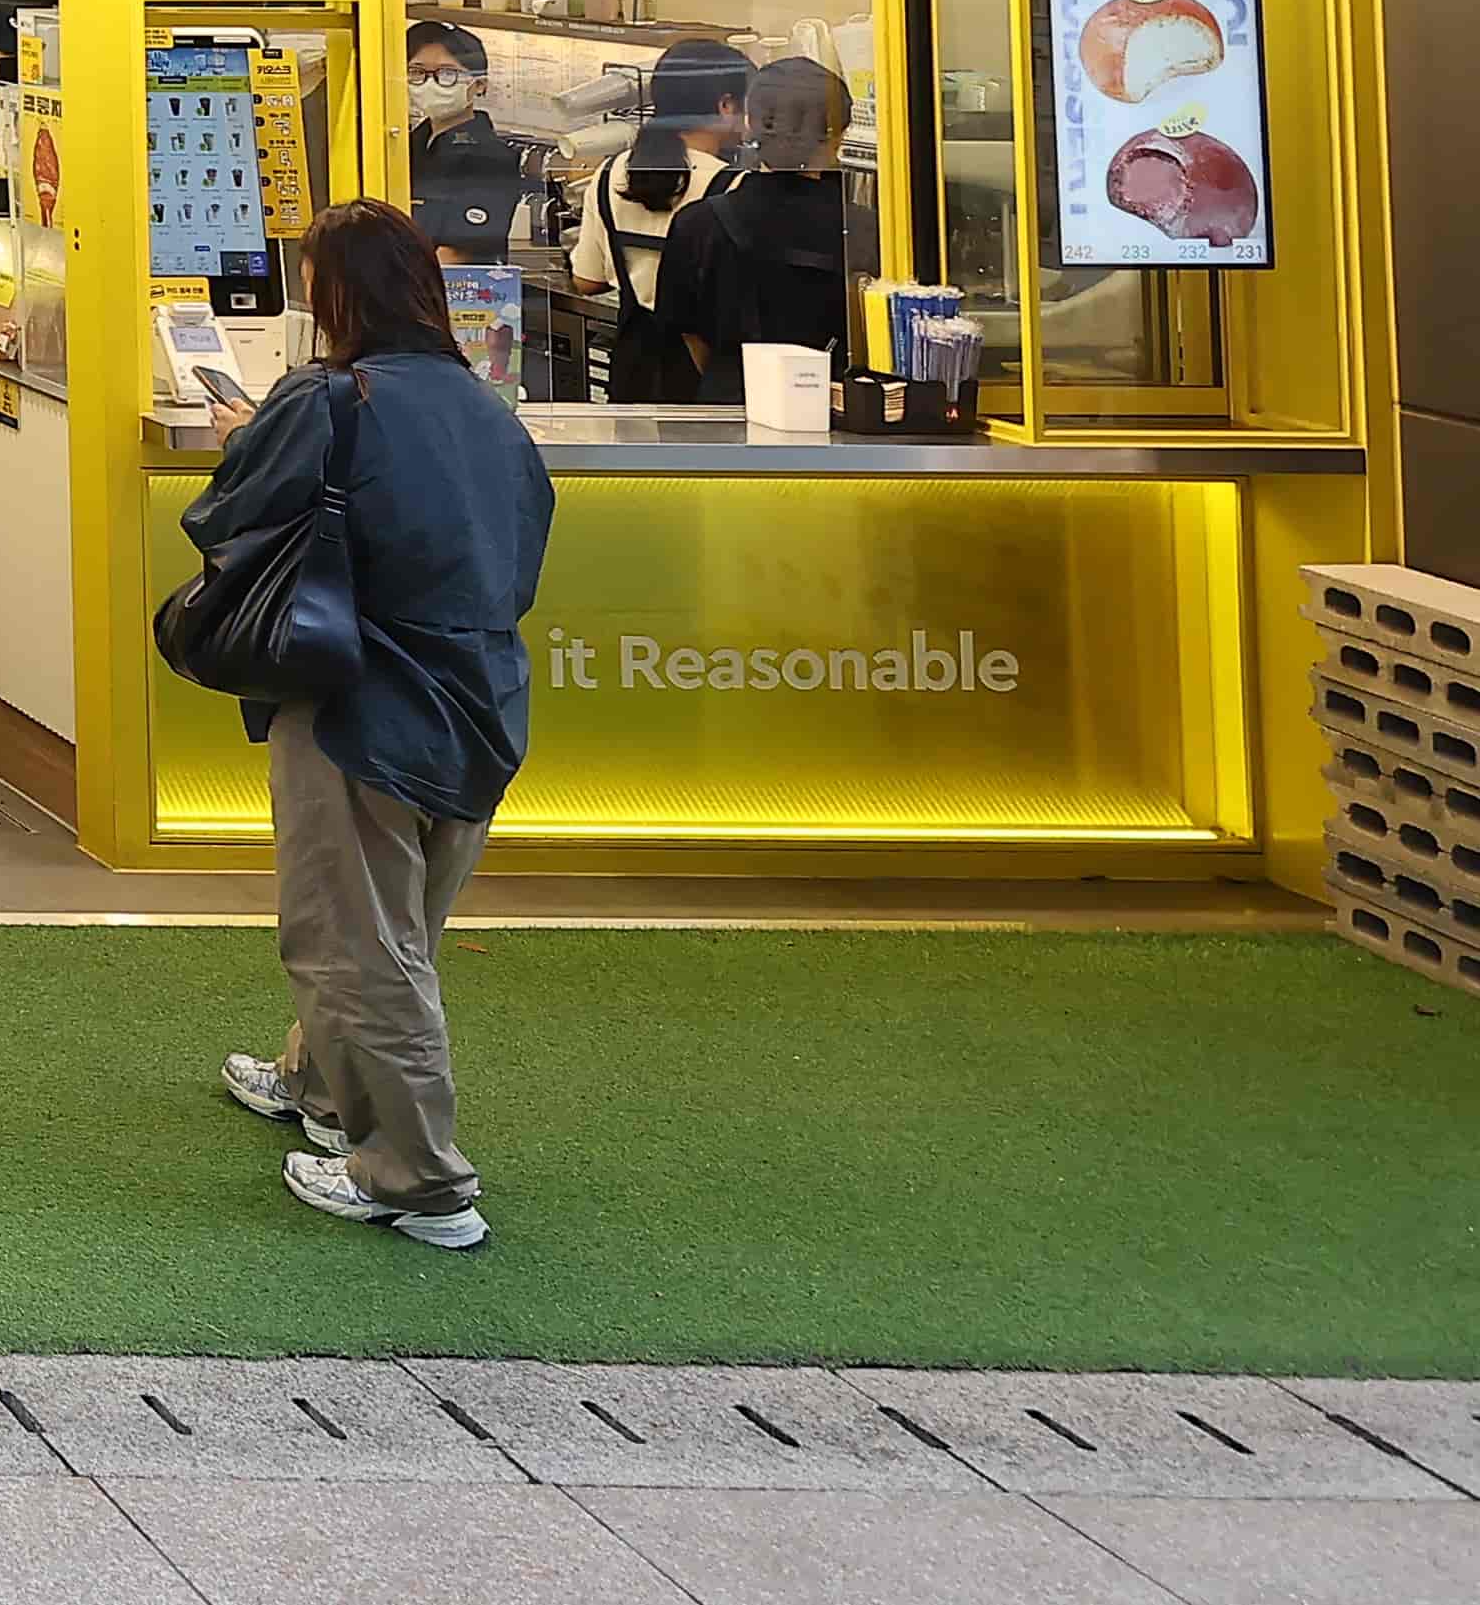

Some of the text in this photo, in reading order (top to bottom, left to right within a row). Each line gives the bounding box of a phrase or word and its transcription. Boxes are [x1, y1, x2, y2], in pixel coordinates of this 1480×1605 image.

[1064, 245, 1263, 259] 242 233 232 231
[547, 628, 1020, 693] it Reasonable
